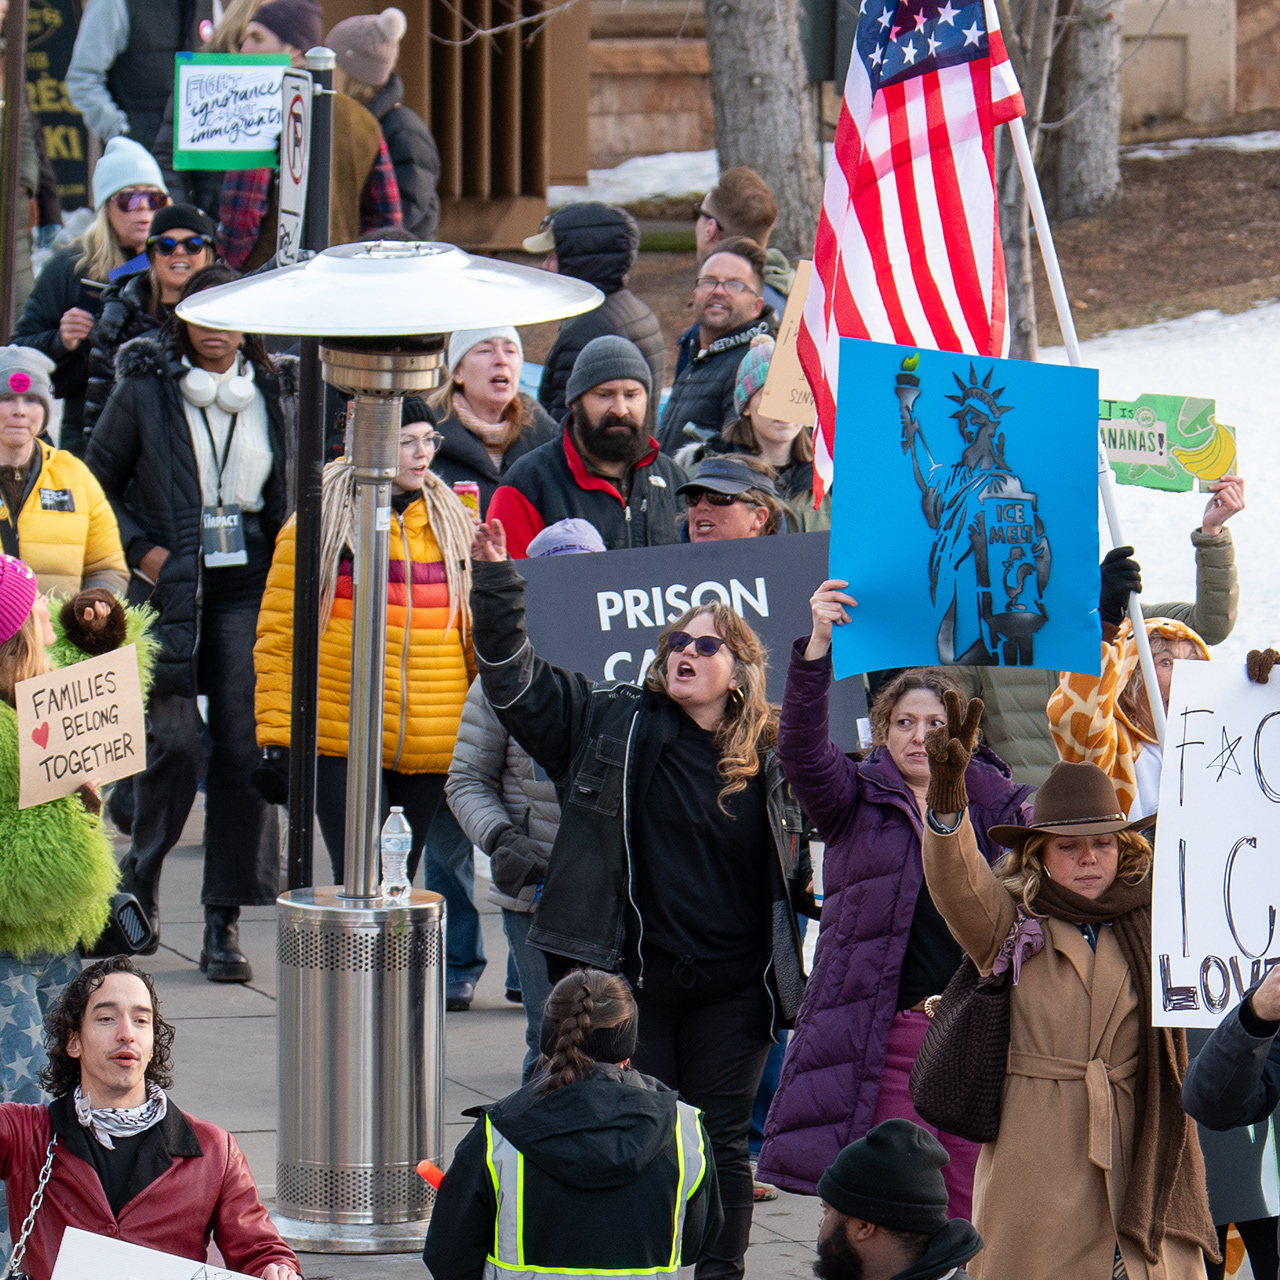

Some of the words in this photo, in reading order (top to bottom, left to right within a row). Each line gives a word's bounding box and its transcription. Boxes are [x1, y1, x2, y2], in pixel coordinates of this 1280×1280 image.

[187, 73, 243, 106] FIGHT
[191, 81, 282, 126] ignorance
[44, 125, 83, 162] KI
[1100, 426, 1164, 456] ANANAS!
[996, 503, 1025, 523] ICE
[989, 524, 1033, 545] MELT
[596, 577, 770, 632] PRISON
[32, 671, 117, 719] FAMILIES
[62, 704, 118, 741] BELONG
[39, 732, 135, 782] TOGETHER
